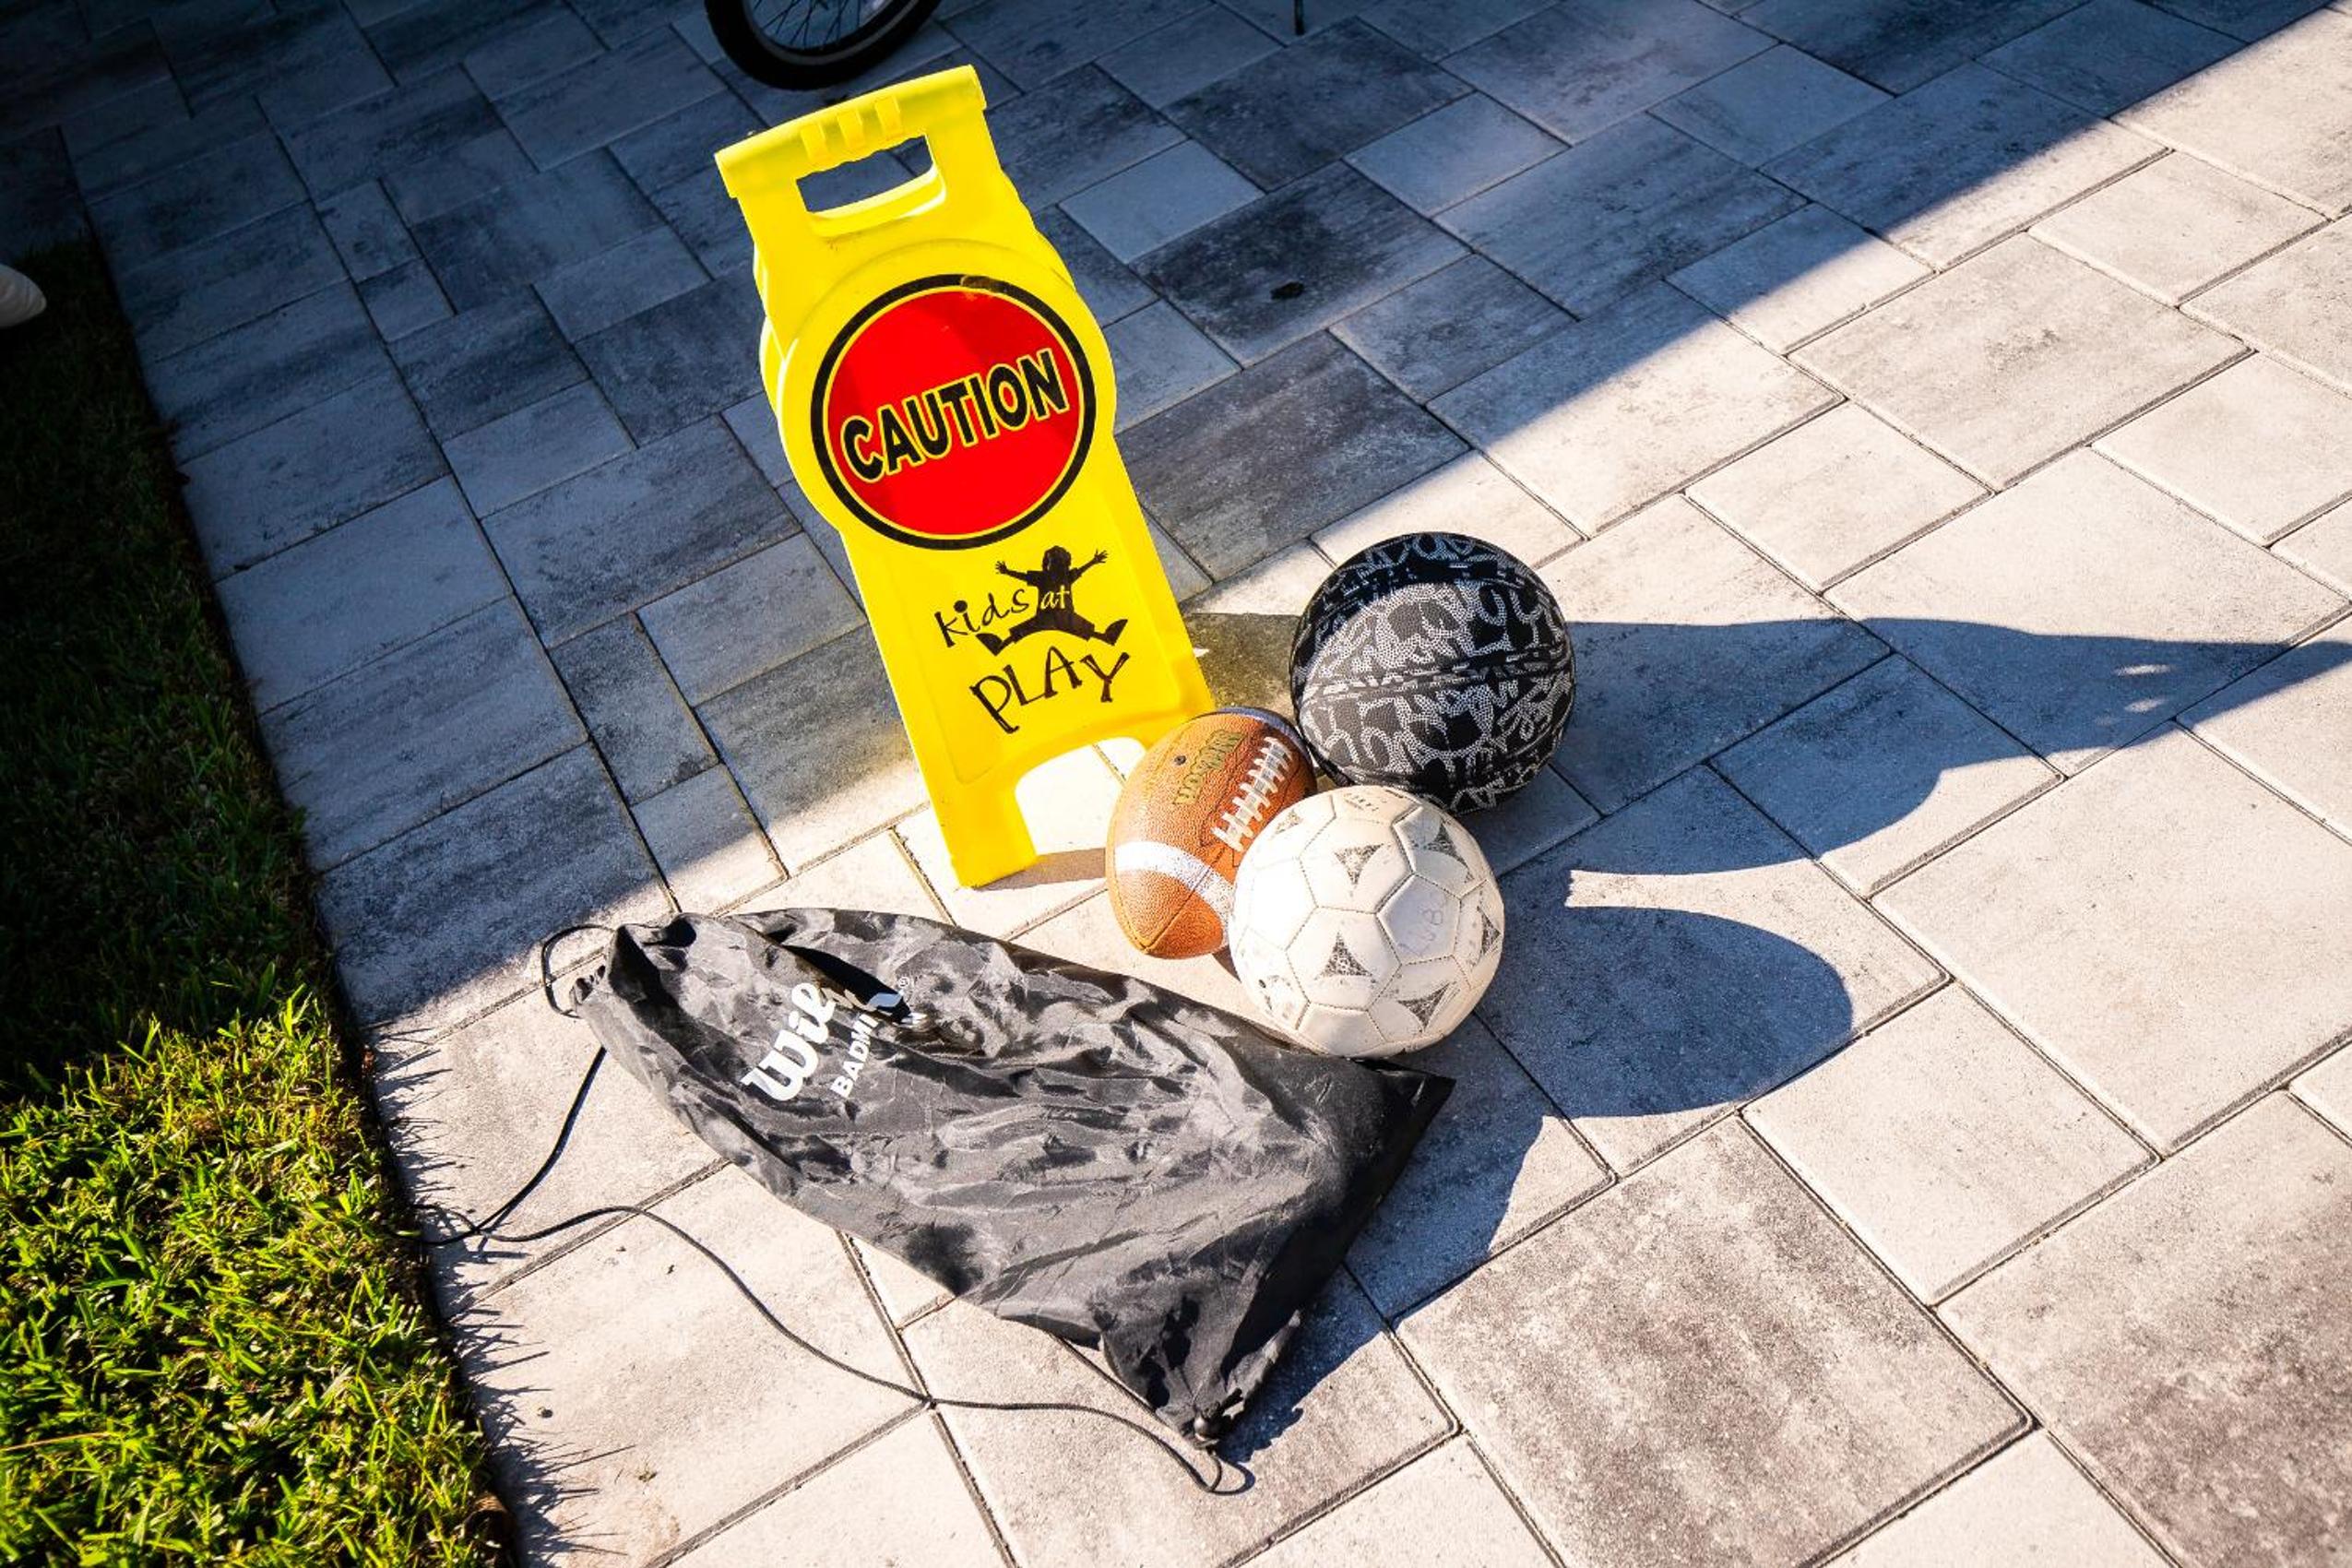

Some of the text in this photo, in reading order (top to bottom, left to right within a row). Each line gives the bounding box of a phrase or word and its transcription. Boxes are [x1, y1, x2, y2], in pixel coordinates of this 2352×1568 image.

[840, 348, 1070, 482] CAUTION
[1040, 585, 1070, 610] at
[740, 982, 904, 1101] Wil
